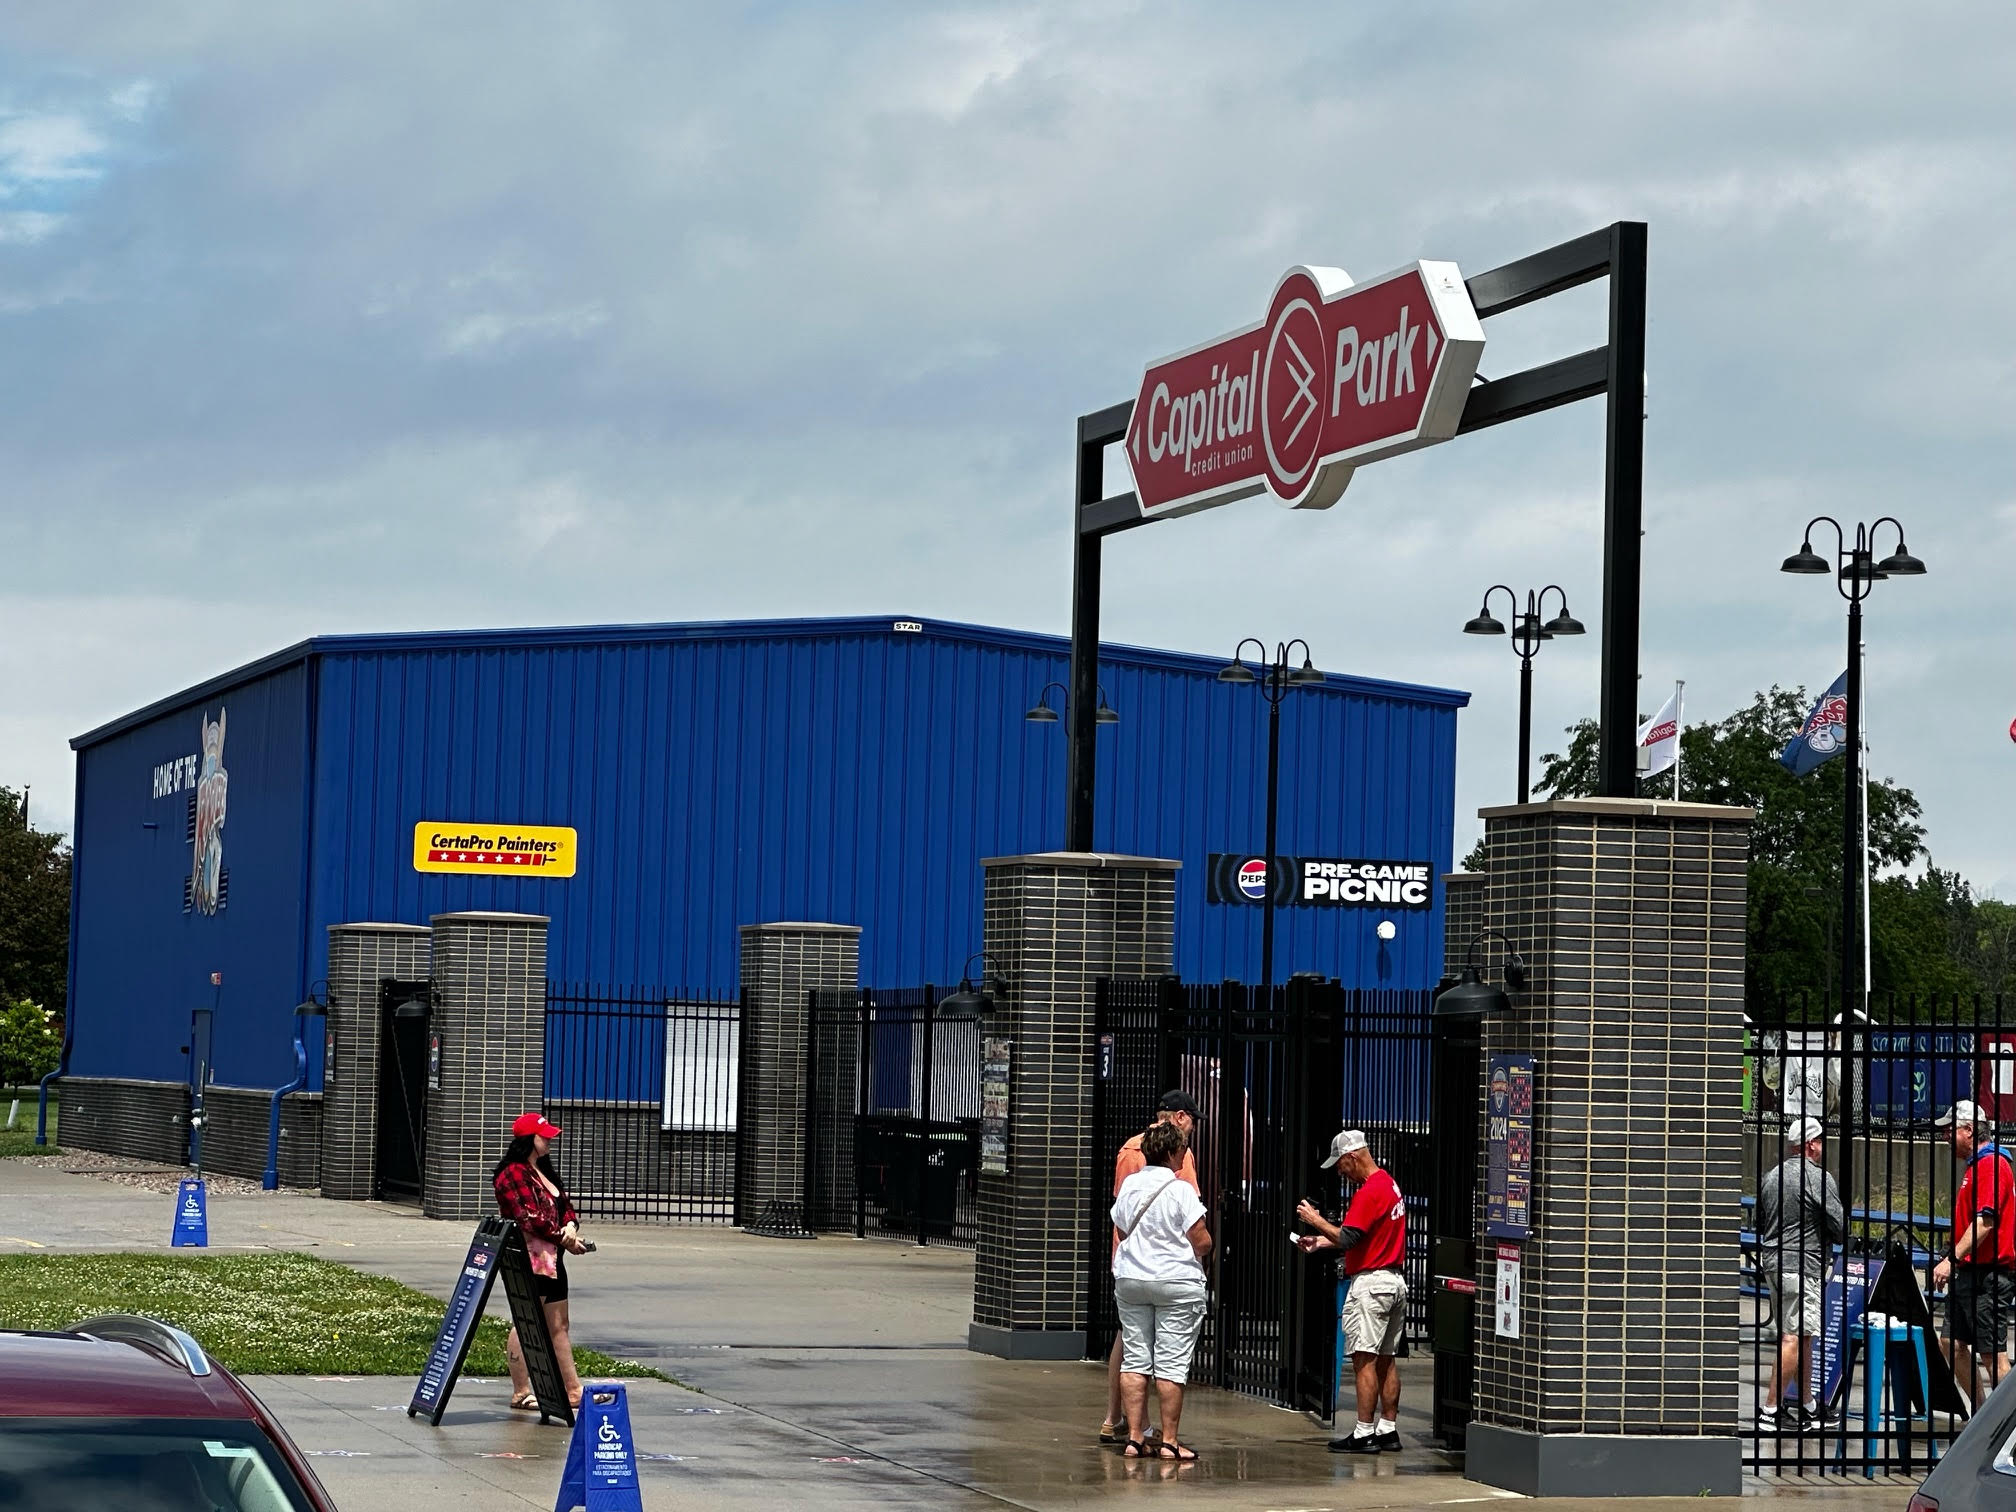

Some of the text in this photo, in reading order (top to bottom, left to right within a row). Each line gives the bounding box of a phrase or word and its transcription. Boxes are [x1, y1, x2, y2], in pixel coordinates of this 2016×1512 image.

[1149, 305, 1421, 473] Capital Park
[1192, 443, 1254, 477] credit union
[153, 754, 197, 799] HOME OF THE
[431, 834, 557, 852] CertaPro Painters
[1241, 874, 1266, 884] PEPS
[1304, 862, 1428, 881] PRE-GAME
[1304, 878, 1428, 904] PICNIC
[1103, 1055, 1109, 1077] 3
[1491, 1117, 1507, 1140] 2024
